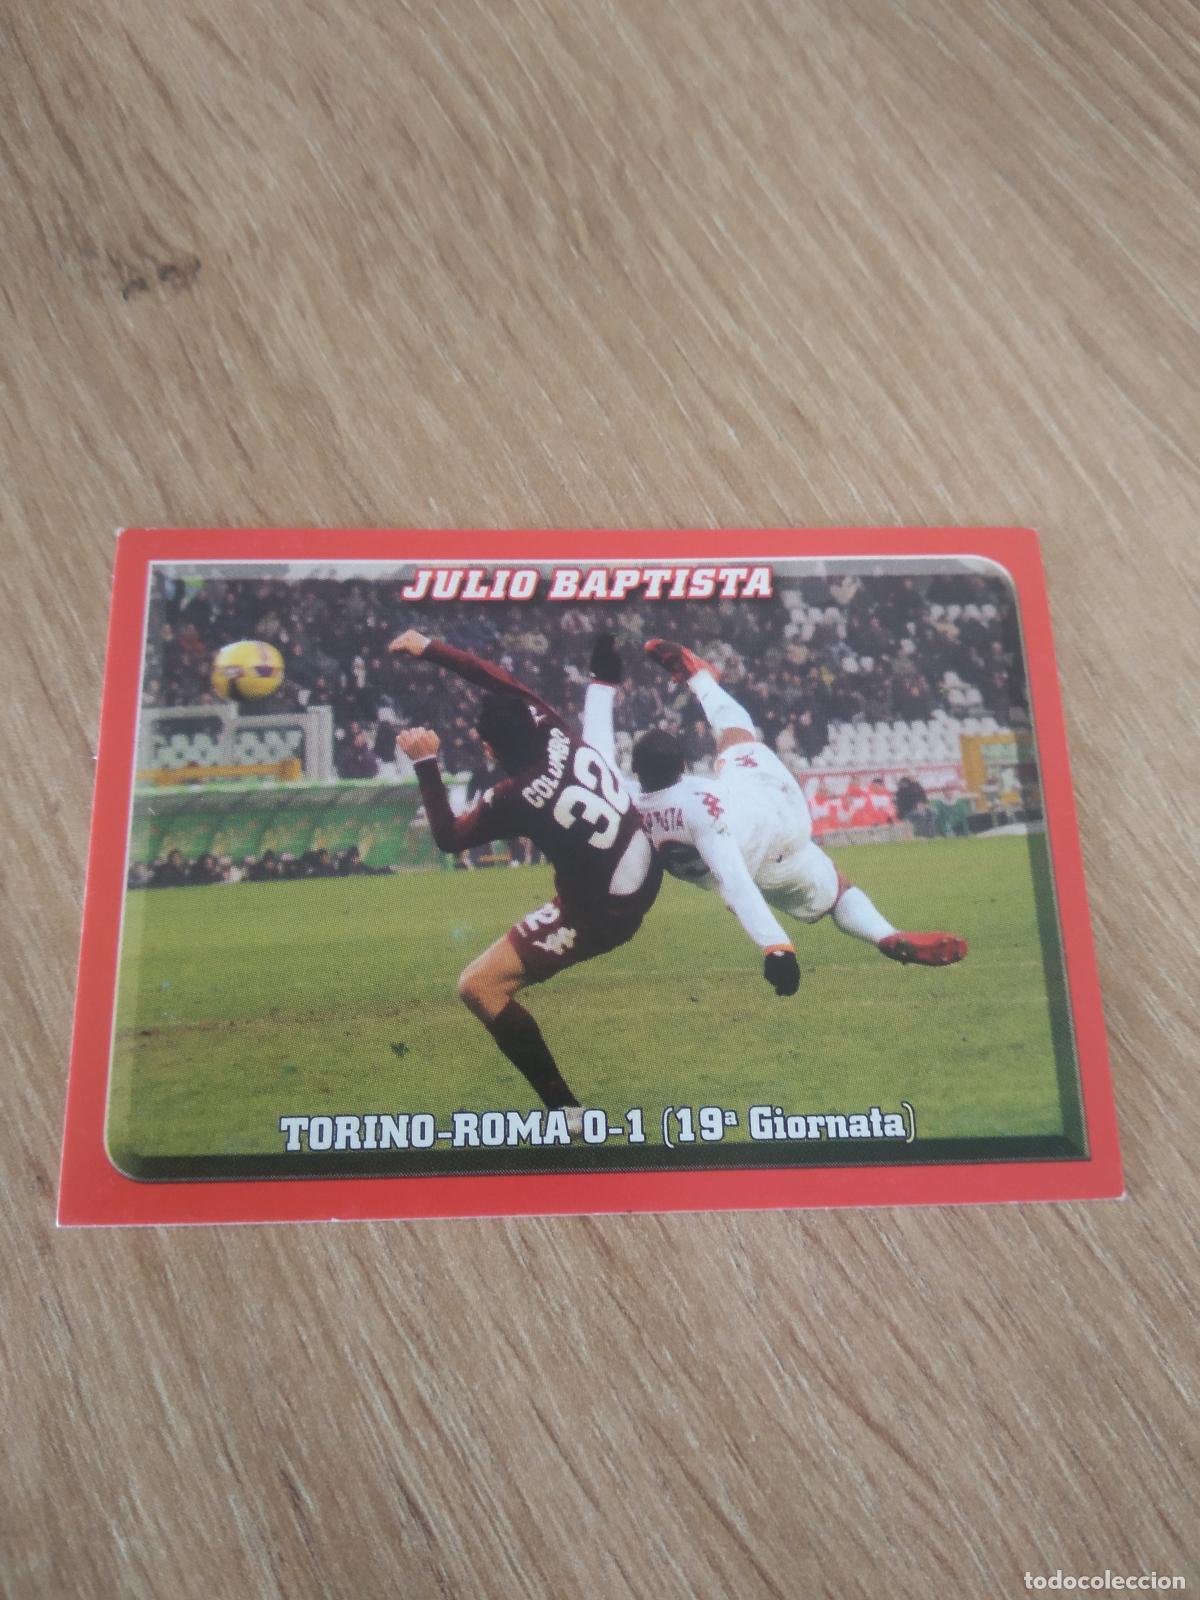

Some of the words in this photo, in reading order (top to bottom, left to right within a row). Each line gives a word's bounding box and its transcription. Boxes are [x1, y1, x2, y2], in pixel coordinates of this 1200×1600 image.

[402, 567, 537, 600] JULIO
[548, 565, 771, 600] BAPTISTA
[553, 746, 630, 849] 32
[280, 1109, 572, 1151] TORINO-ROMA
[583, 1108, 646, 1144] 0-1
[748, 1102, 916, 1143] Giornata)
